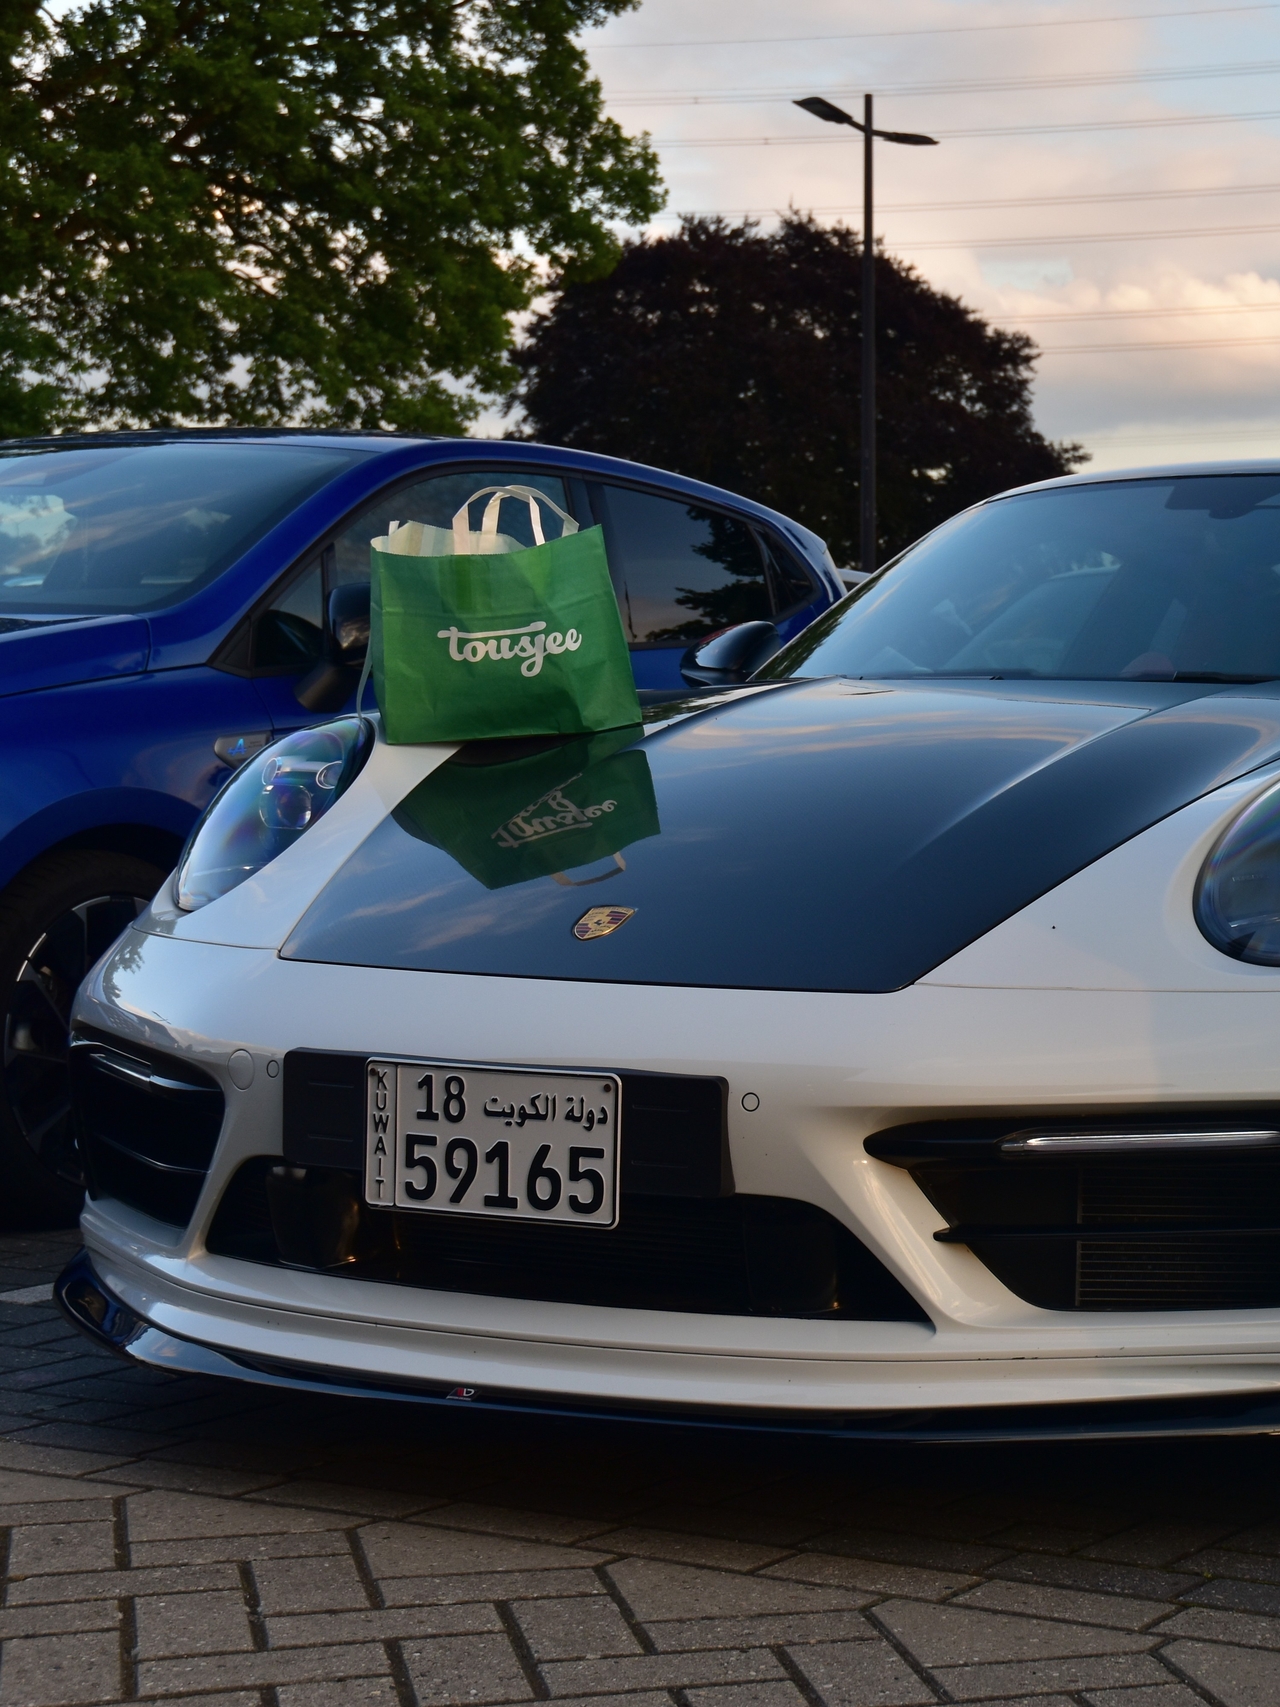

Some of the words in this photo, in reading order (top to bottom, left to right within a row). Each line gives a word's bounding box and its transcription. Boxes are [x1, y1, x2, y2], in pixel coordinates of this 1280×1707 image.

[416, 1073, 466, 1123] 18
[483, 1093, 557, 1127] الكويت
[564, 1096, 609, 1132] دولة
[372, 1069, 390, 1199] KUWAIT
[404, 1132, 605, 1214] 59165
